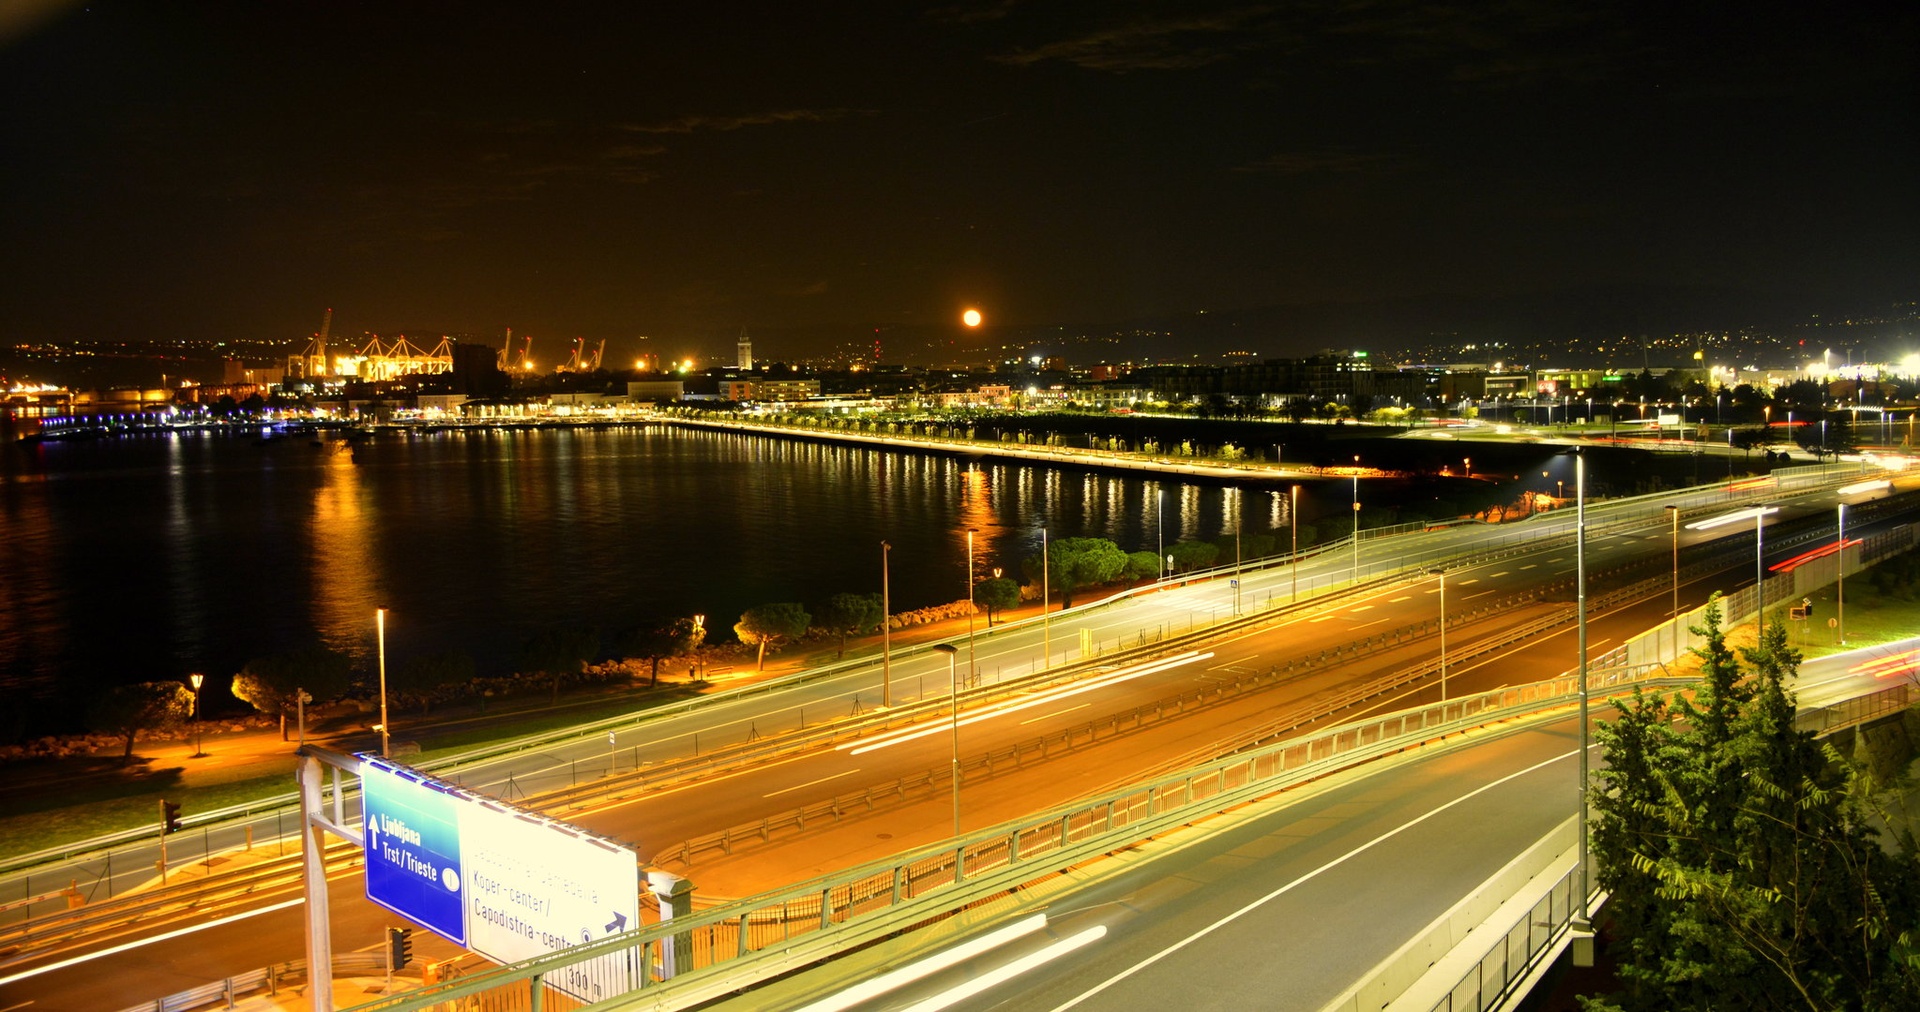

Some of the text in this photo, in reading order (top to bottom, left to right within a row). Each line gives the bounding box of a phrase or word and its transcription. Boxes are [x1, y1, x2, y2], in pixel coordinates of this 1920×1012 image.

[381, 813, 421, 847] Ljubljana
[474, 897, 577, 952] Capodistria-centr
[568, 968, 588, 991] 300
